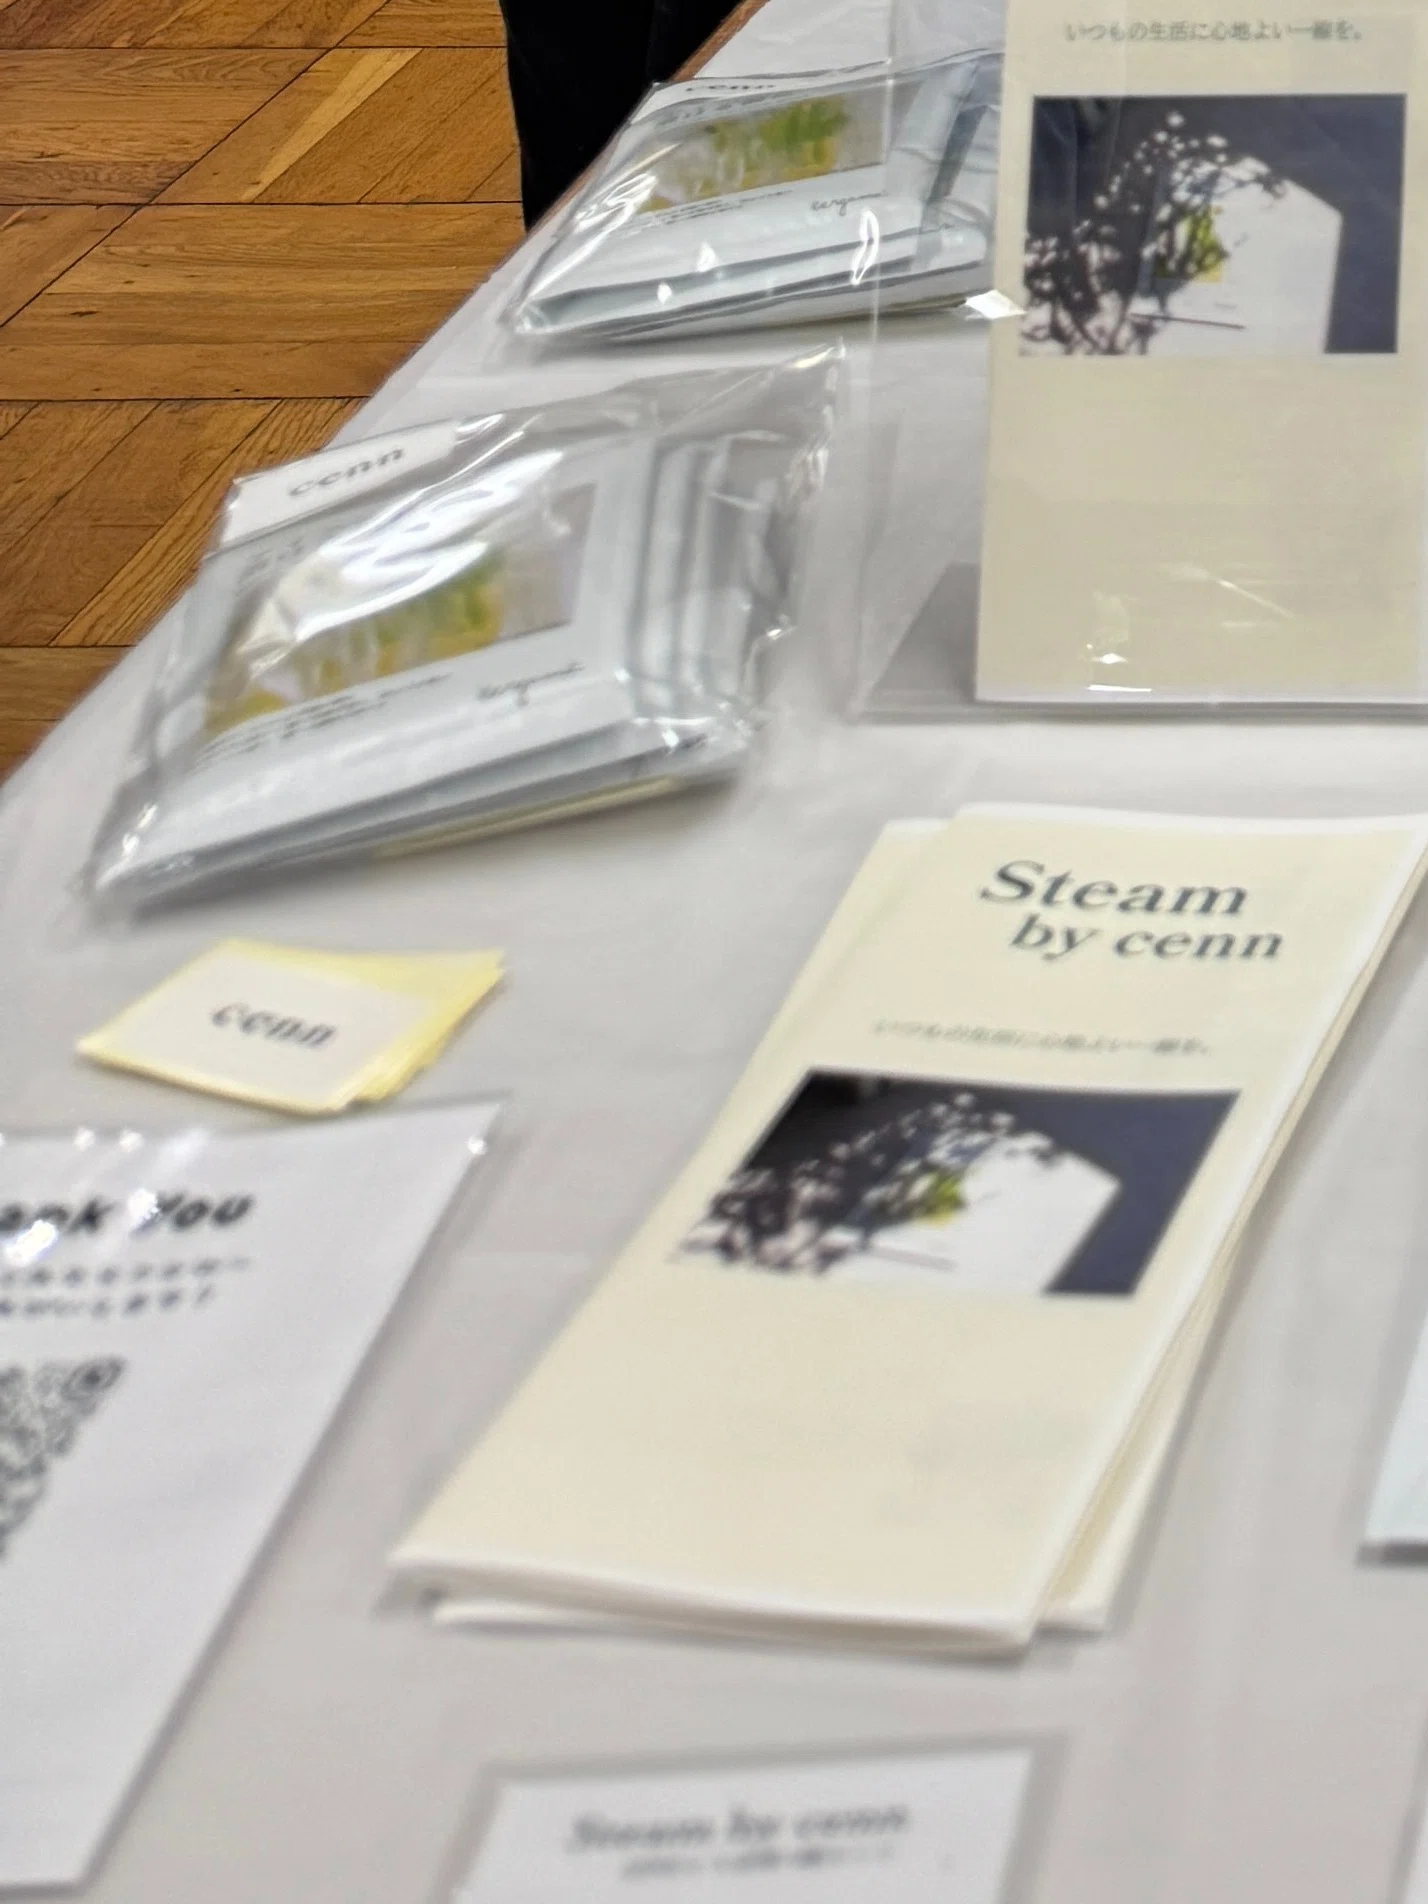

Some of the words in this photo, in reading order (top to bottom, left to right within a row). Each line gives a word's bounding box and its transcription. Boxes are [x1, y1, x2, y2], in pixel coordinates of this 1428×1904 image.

[288, 448, 405, 497] cenn
[979, 859, 1250, 917] Steam
[1009, 913, 1100, 961] by
[1112, 930, 1285, 960] cenn
[210, 1001, 339, 1050] cenn
